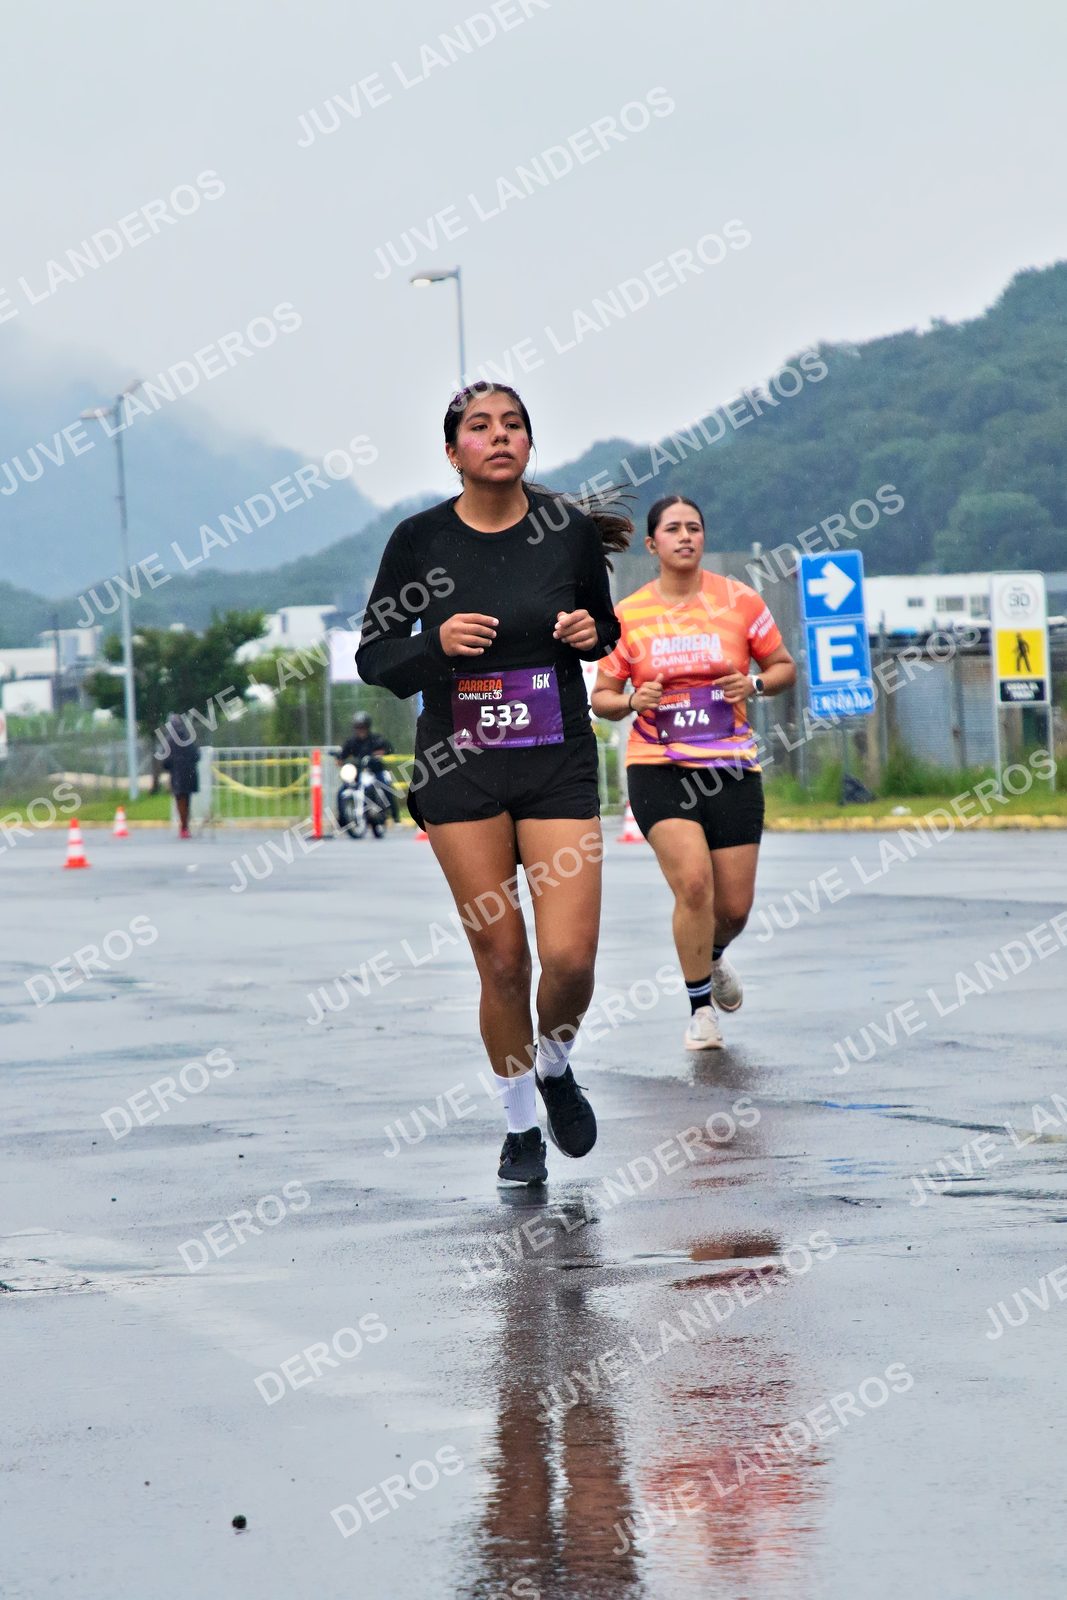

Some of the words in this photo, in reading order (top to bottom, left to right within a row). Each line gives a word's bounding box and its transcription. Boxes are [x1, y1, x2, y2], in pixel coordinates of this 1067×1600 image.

[1008, 592, 1031, 607] 30
[651, 633, 720, 656] CARRERA
[816, 624, 861, 683] E
[458, 679, 502, 692] CARRERA
[532, 673, 550, 690] 15K
[458, 692, 492, 700] OMNILIFE
[480, 703, 530, 727] 532
[673, 709, 710, 728] 474
